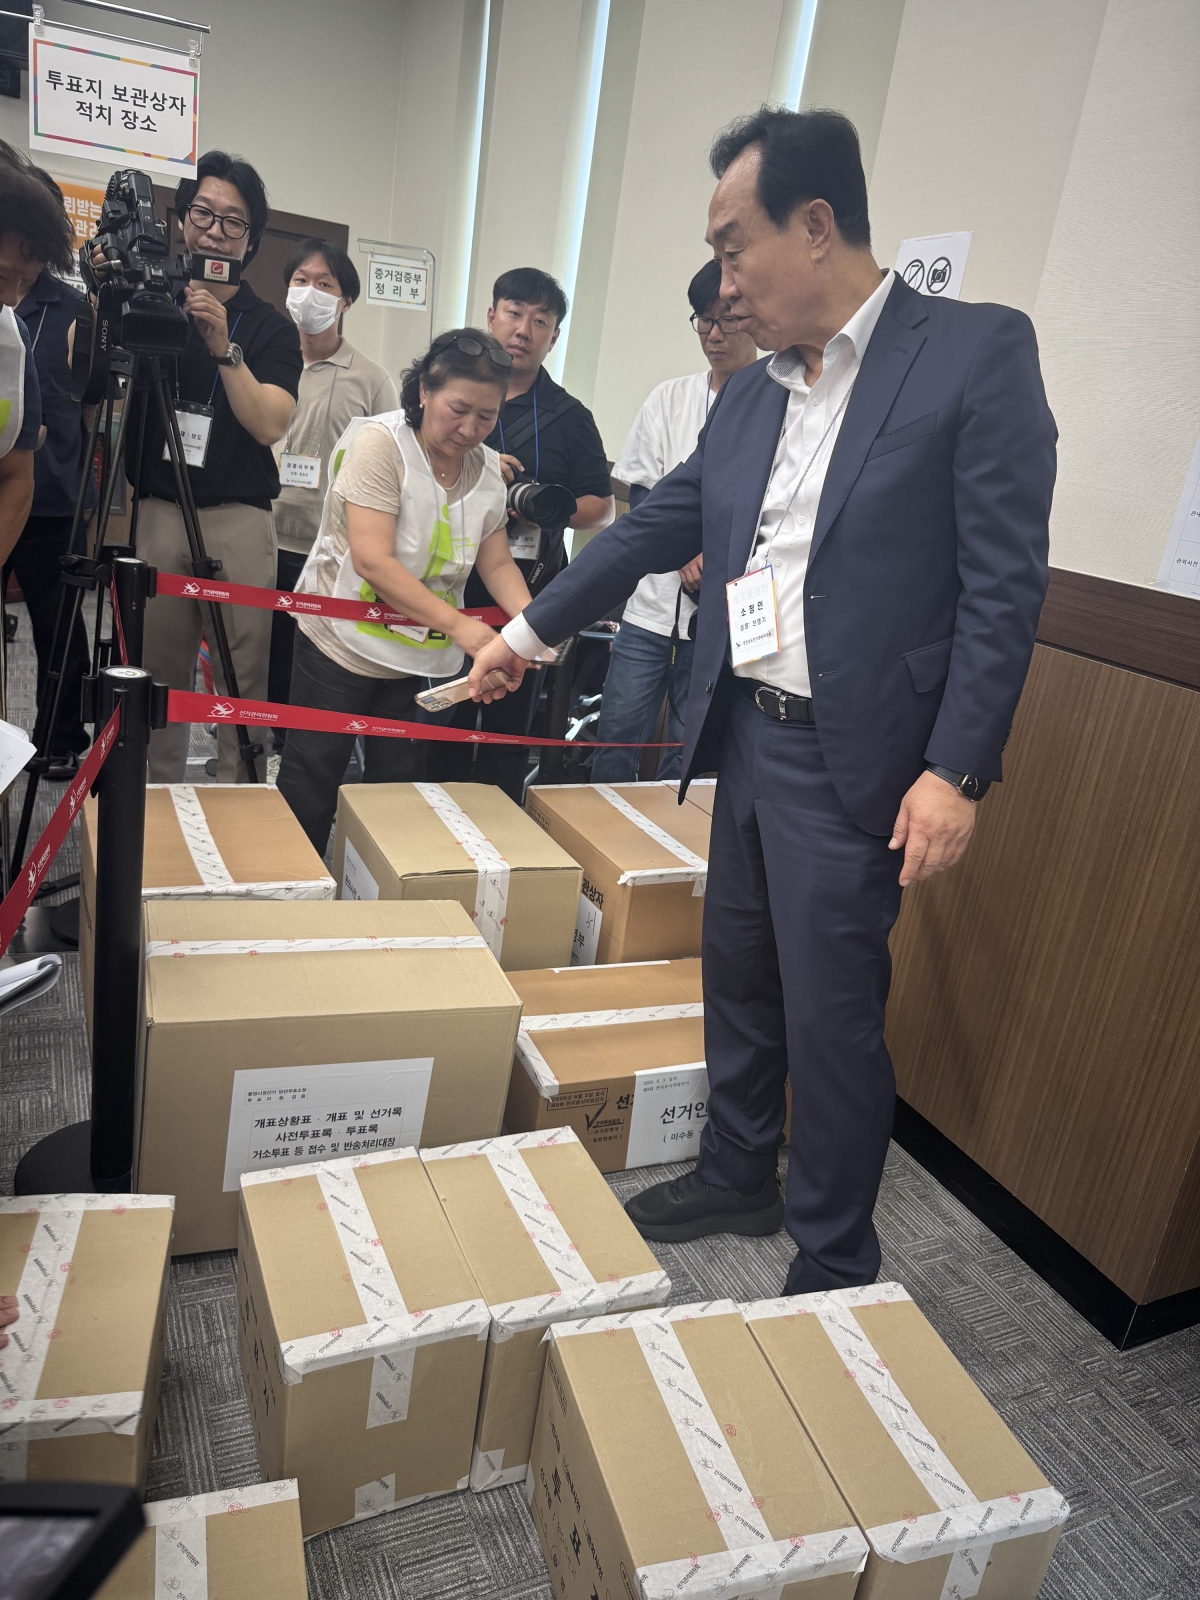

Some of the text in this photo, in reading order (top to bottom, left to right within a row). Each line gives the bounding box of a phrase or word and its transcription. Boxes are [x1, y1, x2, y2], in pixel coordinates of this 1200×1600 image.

[46, 70, 186, 116] 투표지 보관상자
[76, 100, 158, 132] 적치 장소
[374, 268, 422, 284] 증거검증부
[530, 562, 544, 584] Canon
[740, 600, 764, 618] 소청인
[616, 1094, 634, 1110] 선
[254, 1114, 312, 1129] 개표상황표
[326, 1112, 348, 1122] 개표
[354, 1110, 365, 1120] 및
[370, 1106, 403, 1119] 선거록
[275, 1128, 332, 1142] 사전투표록
[345, 1124, 379, 1136] 투표록
[671, 1130, 694, 1141] 미수동
[252, 1137, 396, 1160] 거소투표 등 접수 및 반송처리대장
[661, 1351, 685, 1370] 선거관리위원회
[859, 1358, 885, 1377] 선거관리위원회
[677, 1387, 703, 1408] 선거관리위원회
[881, 1394, 909, 1413] 선거관리위원회
[694, 1426, 722, 1449] 선거관리위원회
[907, 1432, 936, 1452] 선거관리위원회
[714, 1469, 743, 1492] 선거관리위원회
[935, 1472, 965, 1494] 선거관리위원회
[978, 1506, 994, 1531] 선거관리위원회
[1020, 1498, 1034, 1520] 선거관리위원회
[735, 1515, 765, 1539] 선거관리위원회
[935, 1516, 952, 1542] 선거관리위원회
[828, 1535, 848, 1559] 선거관리위원회
[891, 1526, 910, 1553] 선거관리위원회
[177, 1542, 200, 1567] 선거관리위원회
[779, 1544, 800, 1569] 선거관리위원회
[677, 1564, 701, 1590] 선거관리위원회
[729, 1554, 751, 1579] 선거관리위원회
